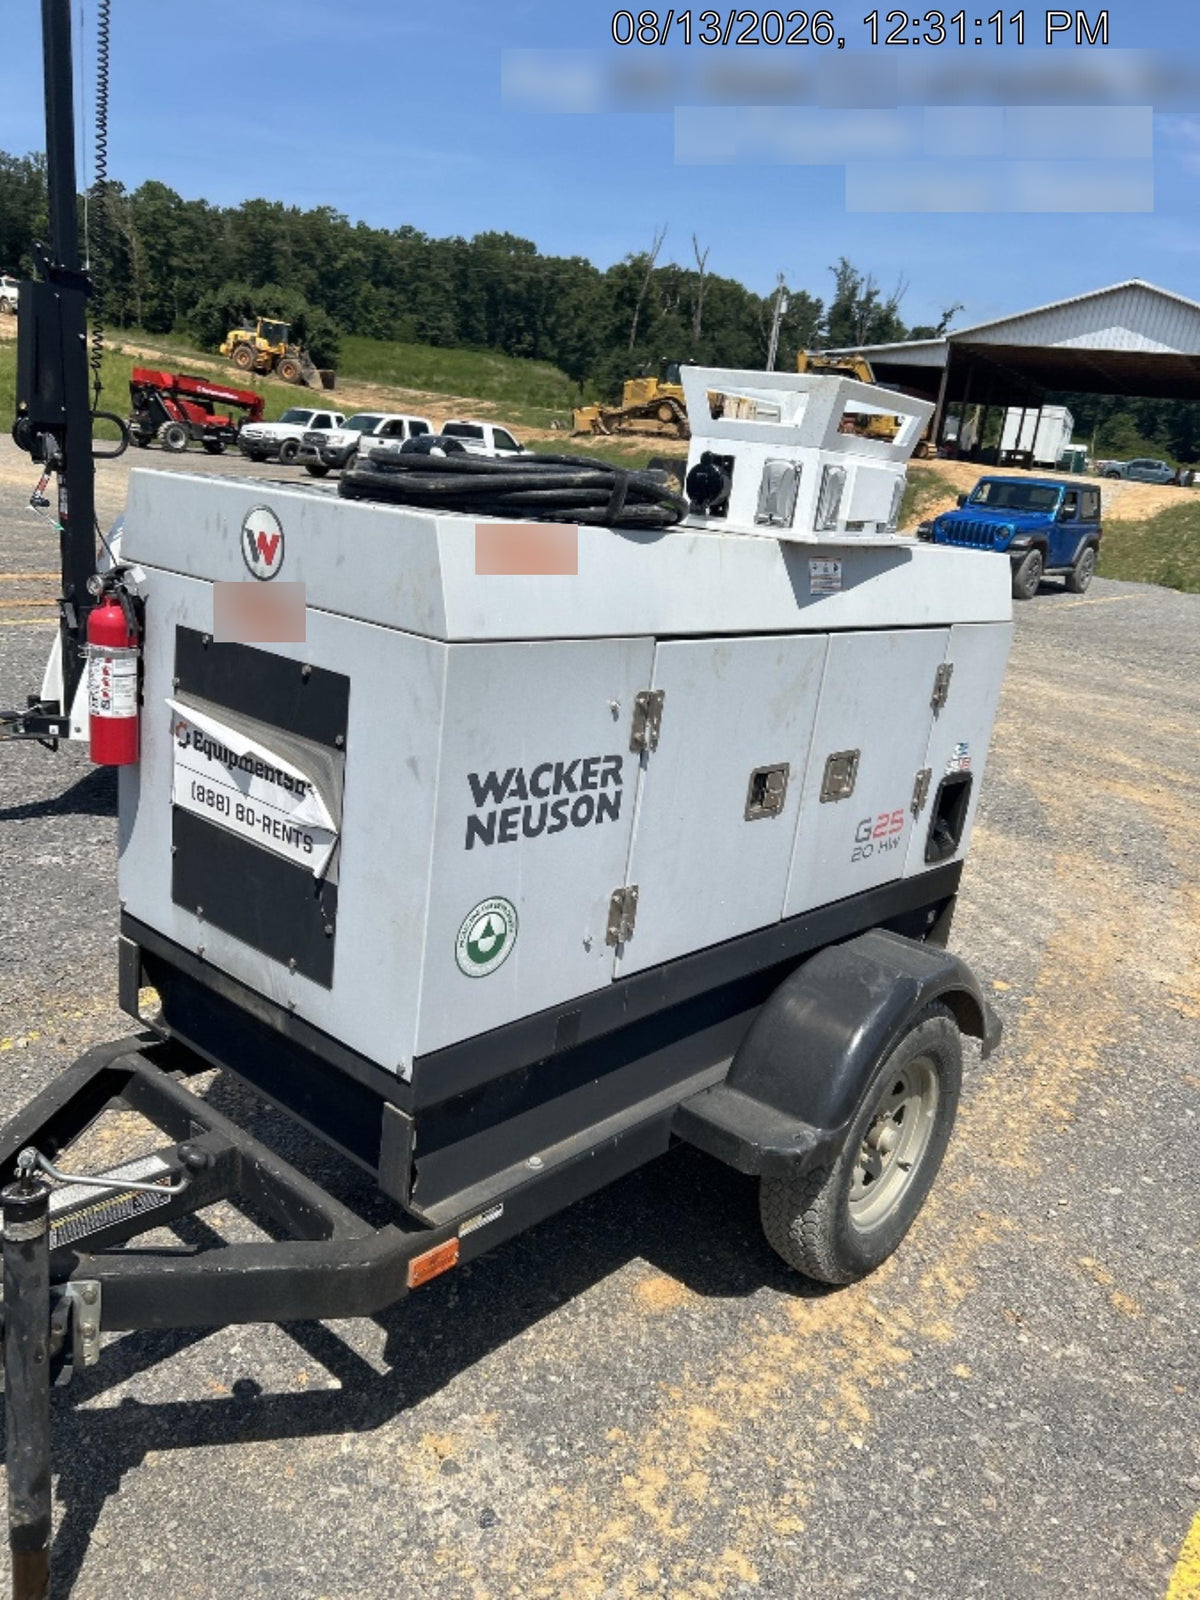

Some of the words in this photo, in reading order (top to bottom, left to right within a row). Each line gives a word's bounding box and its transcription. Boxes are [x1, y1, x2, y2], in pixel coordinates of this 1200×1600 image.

[191, 780, 230, 816] (888)
[467, 754, 623, 808] WACKER
[465, 789, 622, 850] NEUSON
[855, 808, 904, 843] G25
[851, 843, 874, 862] 20
